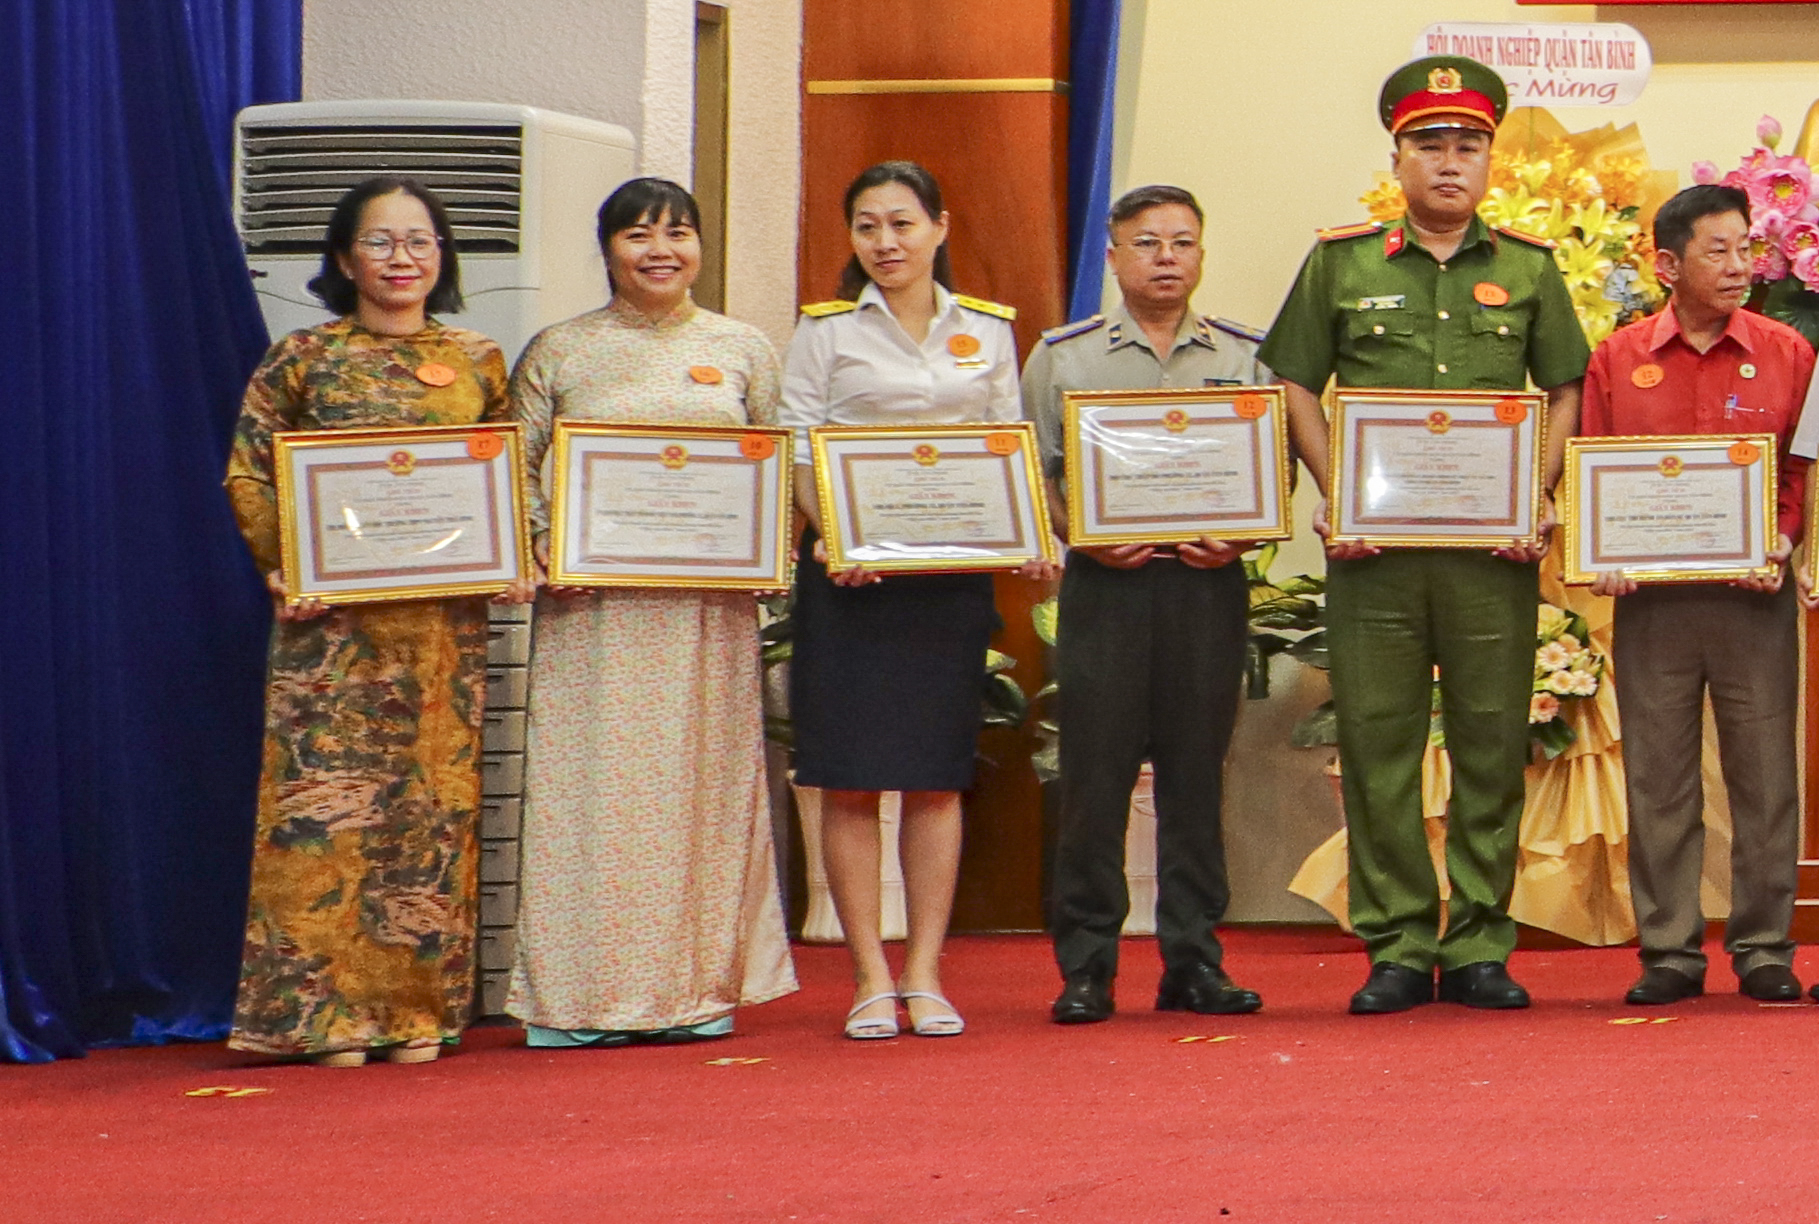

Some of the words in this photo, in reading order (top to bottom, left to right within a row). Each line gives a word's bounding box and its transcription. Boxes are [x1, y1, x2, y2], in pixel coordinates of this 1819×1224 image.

[1497, 28, 1542, 75] NGHIỆP
[1543, 29, 1578, 77] QUẬN
[1581, 30, 1603, 70] TÂN
[1606, 30, 1636, 71] BÌNH
[1524, 77, 1619, 104] Mừng
